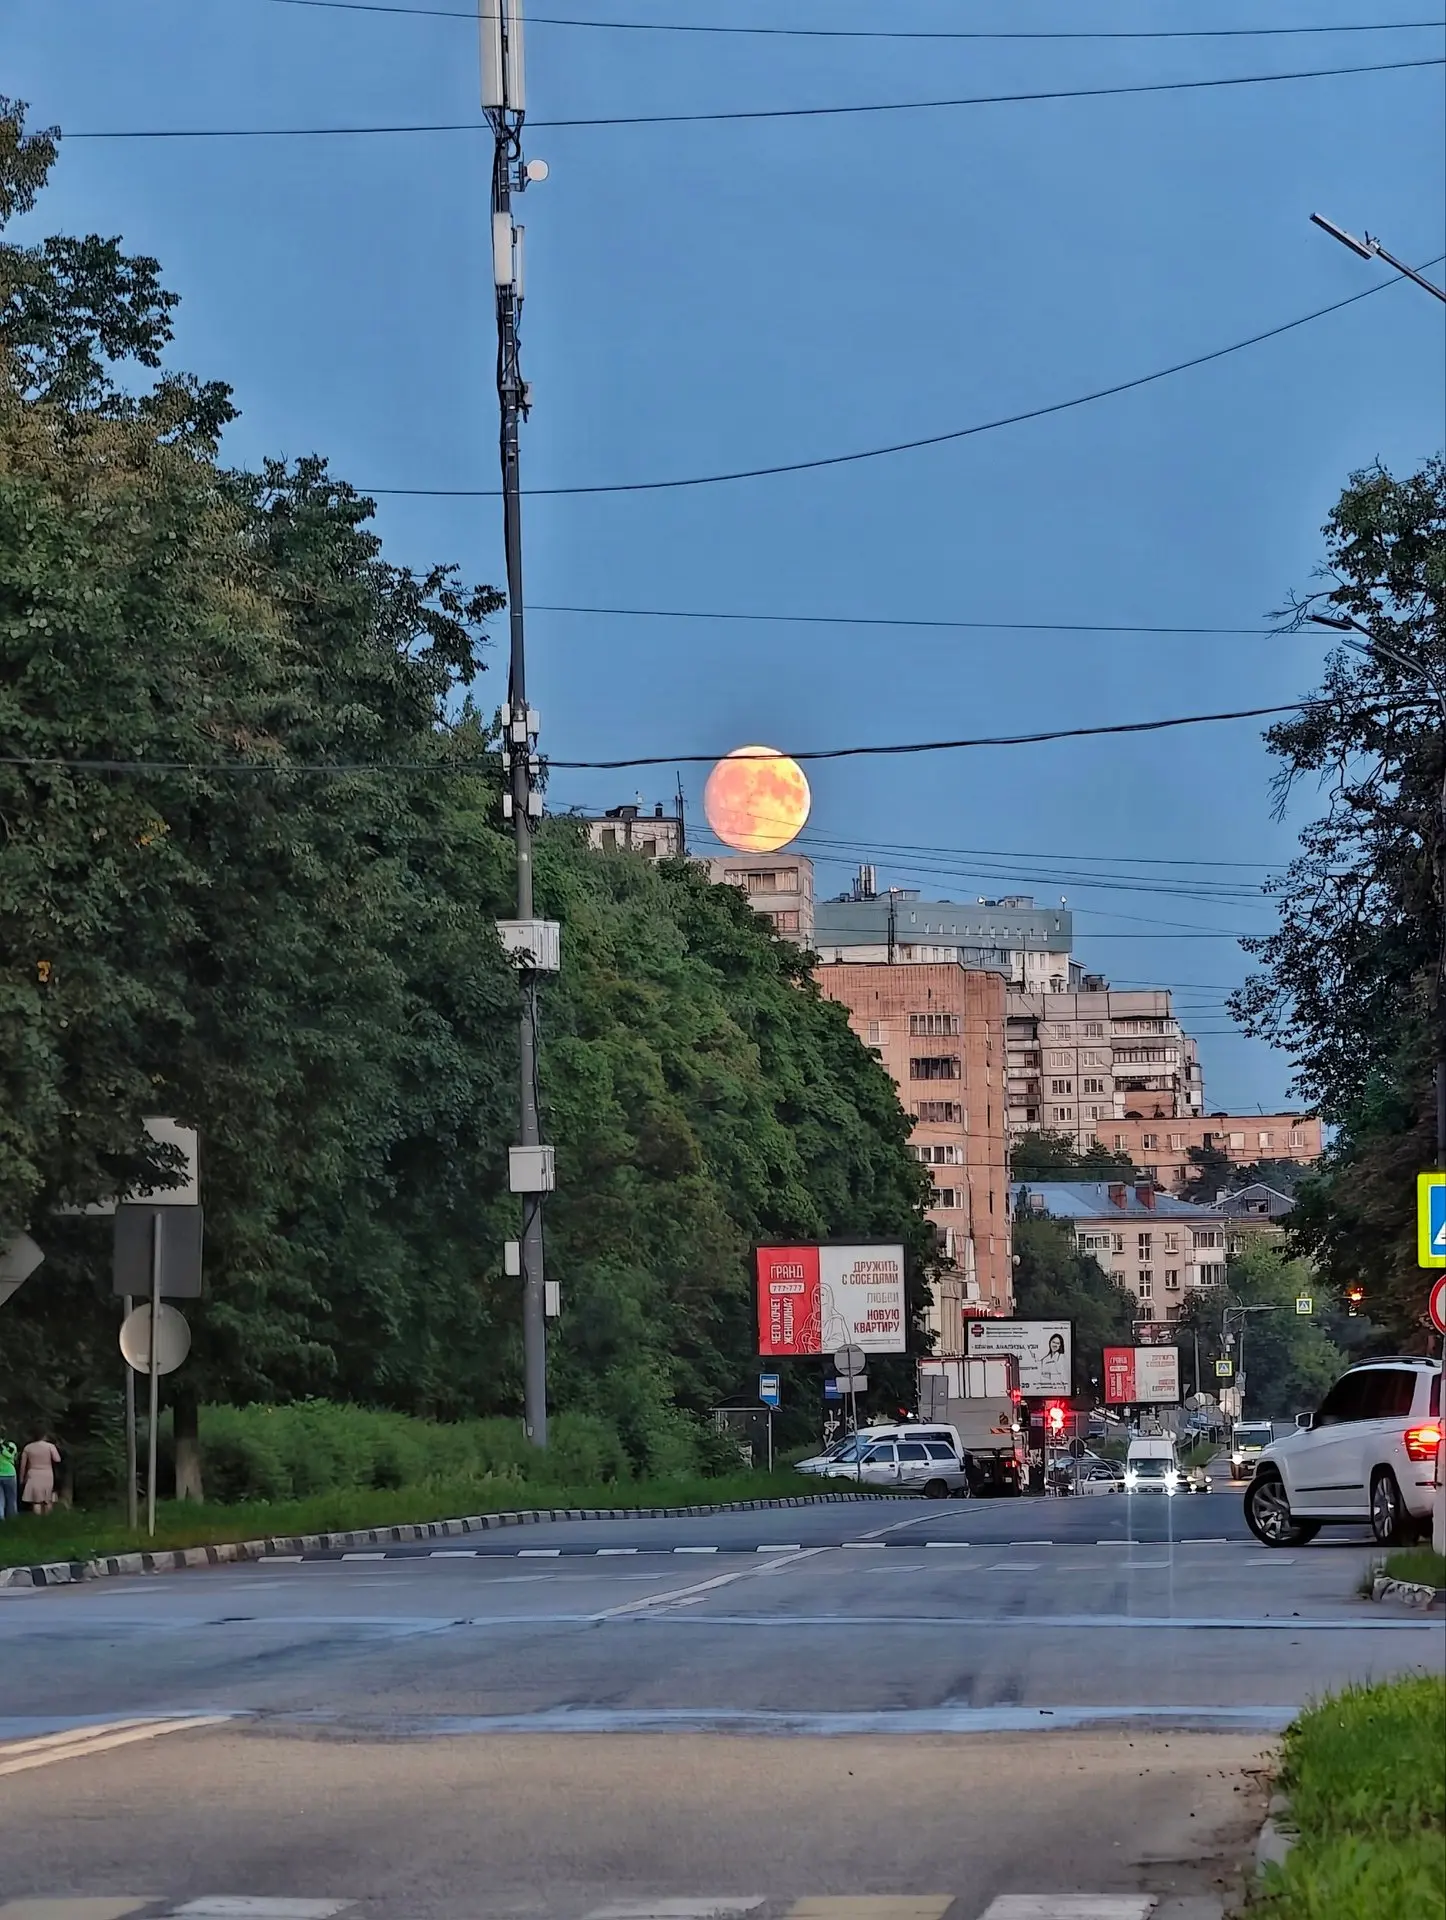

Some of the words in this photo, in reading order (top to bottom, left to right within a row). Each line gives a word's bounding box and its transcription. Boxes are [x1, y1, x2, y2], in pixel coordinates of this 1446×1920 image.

[770, 1264, 804, 1279] ГРАНД
[853, 1260, 898, 1273] ДРУЖИТЬ
[842, 1273, 847, 1285] С
[849, 1272, 899, 1285] СОСЕДЯМИ
[772, 1284, 802, 1292] 777-777
[770, 1297, 781, 1323] ХОЧЕТ
[867, 1308, 900, 1321] НОВУЮ
[782, 1297, 794, 1345] ЖЕНЩИНА?
[853, 1321, 900, 1334] КВАРТИРУ
[770, 1325, 781, 1345] ЧЕГО
